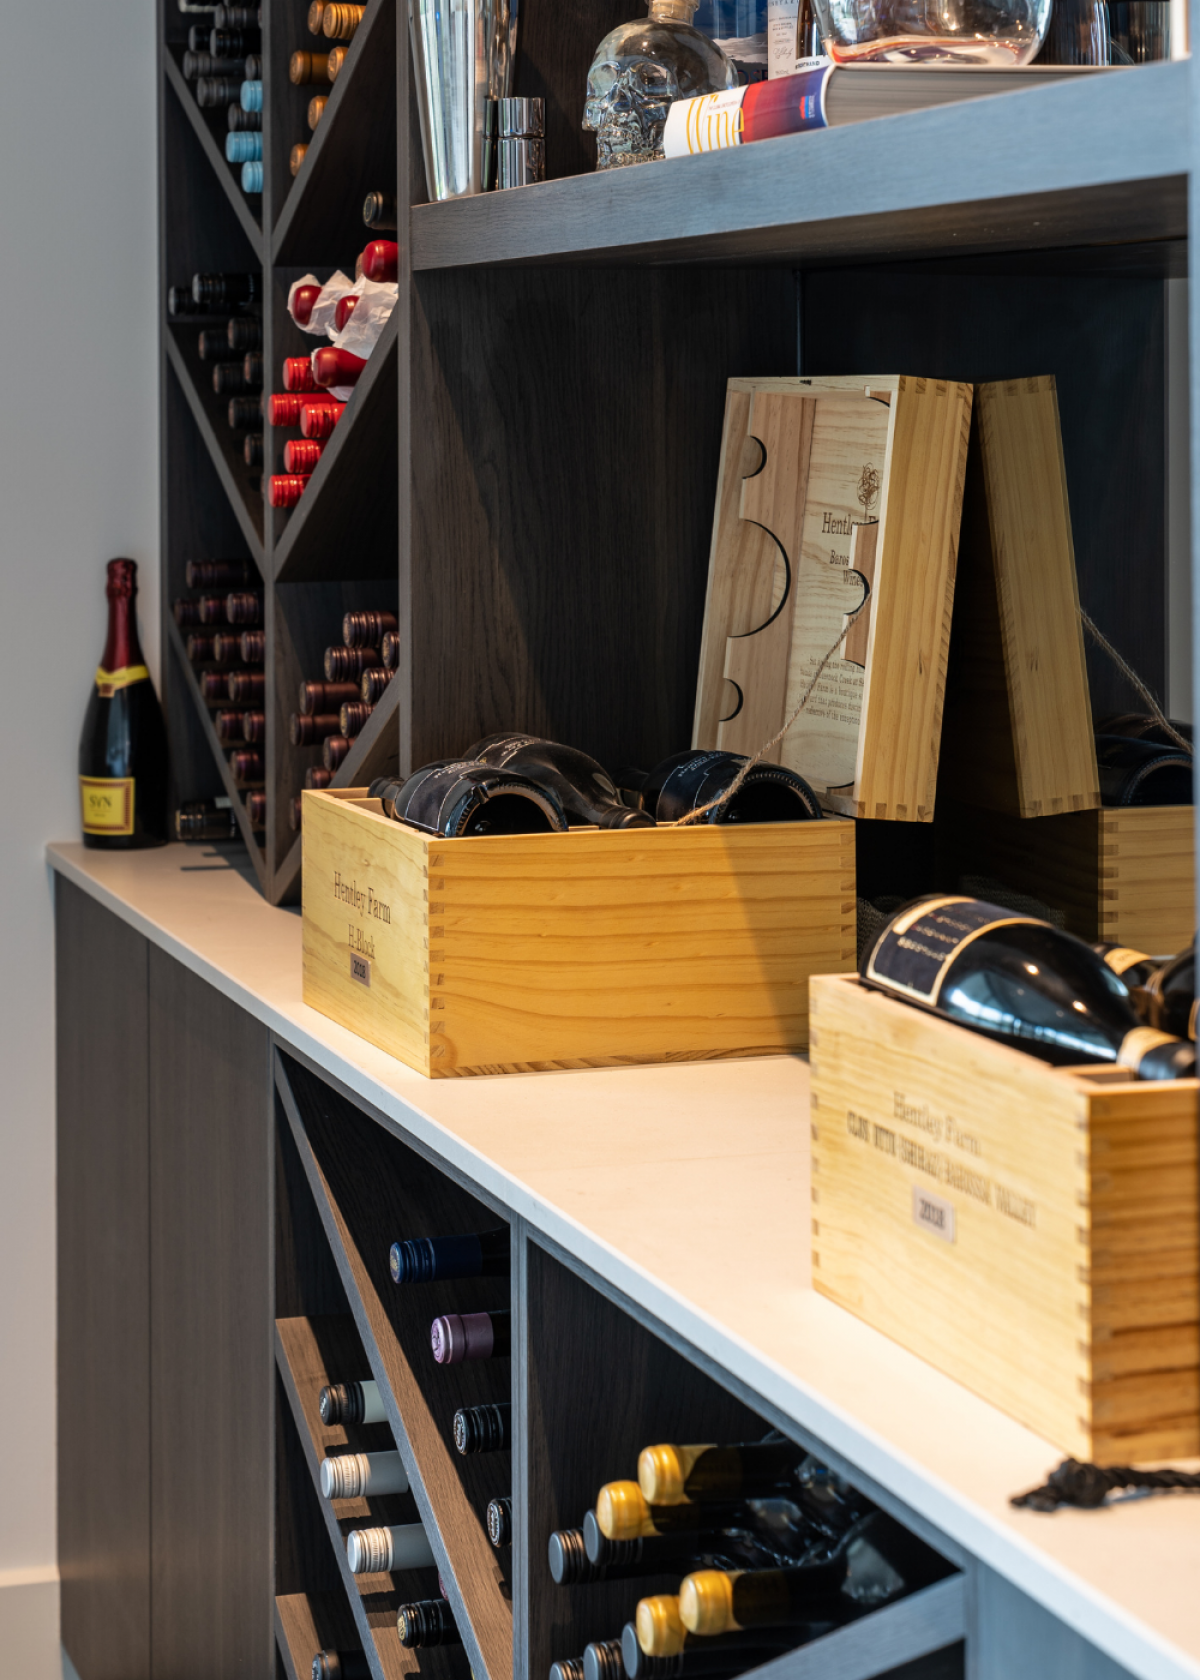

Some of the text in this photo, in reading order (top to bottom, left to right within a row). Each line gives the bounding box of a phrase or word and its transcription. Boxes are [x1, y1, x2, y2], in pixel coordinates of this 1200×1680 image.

[686, 94, 745, 154] Wine
[822, 511, 860, 535] Hentl
[334, 870, 391, 924] Hentley Farm
[348, 923, 376, 960] H-Block
[893, 1090, 981, 1157] Hentley Farm
